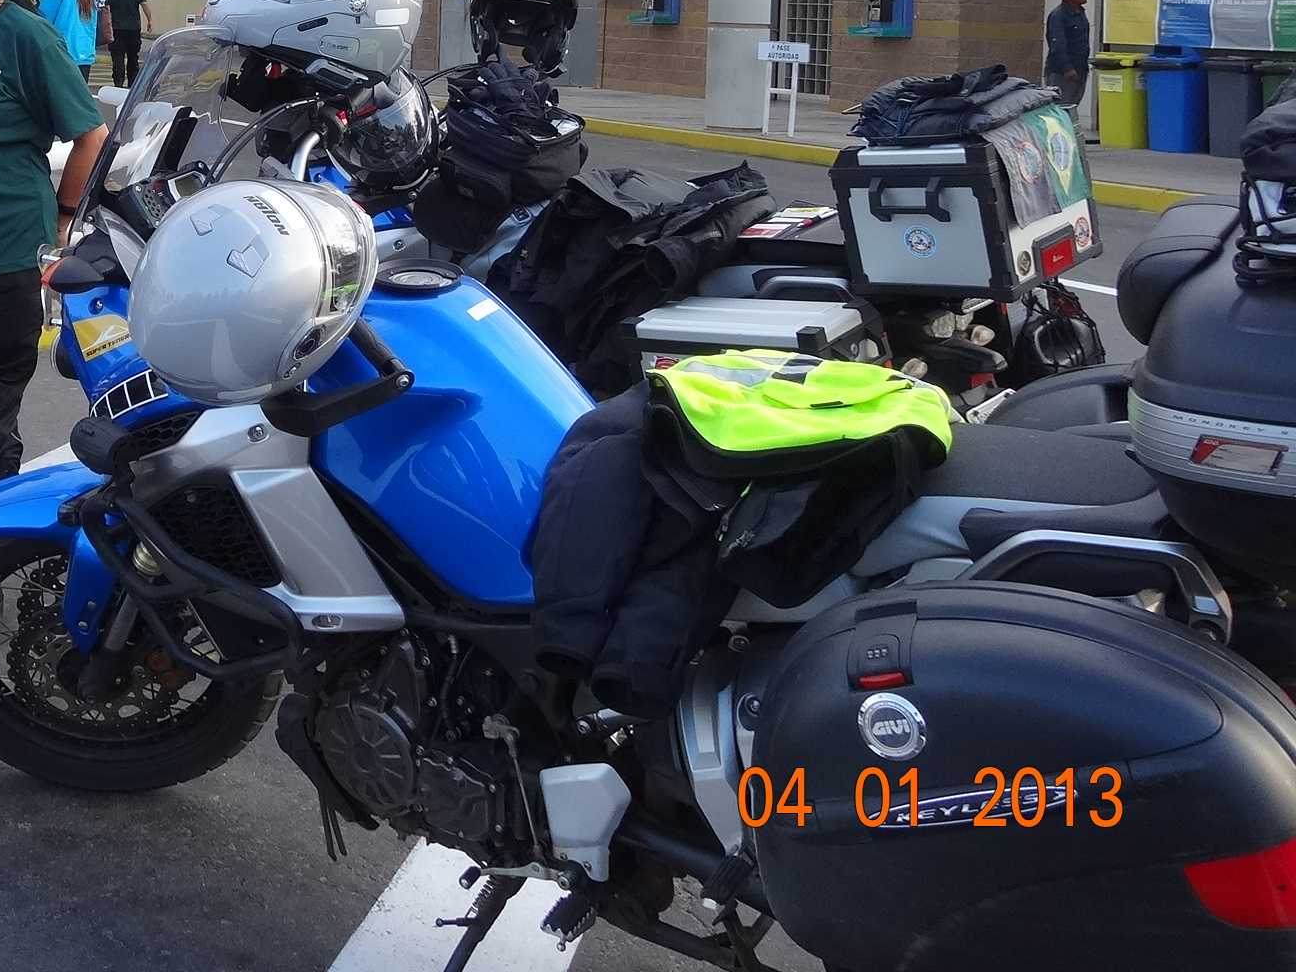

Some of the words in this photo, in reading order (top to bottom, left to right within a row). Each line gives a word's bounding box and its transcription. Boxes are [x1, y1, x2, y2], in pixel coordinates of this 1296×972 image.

[767, 52, 800, 60] AUTORIDAD
[1173, 414, 1265, 432] MONOKEY
[872, 719, 911, 735] GIVI
